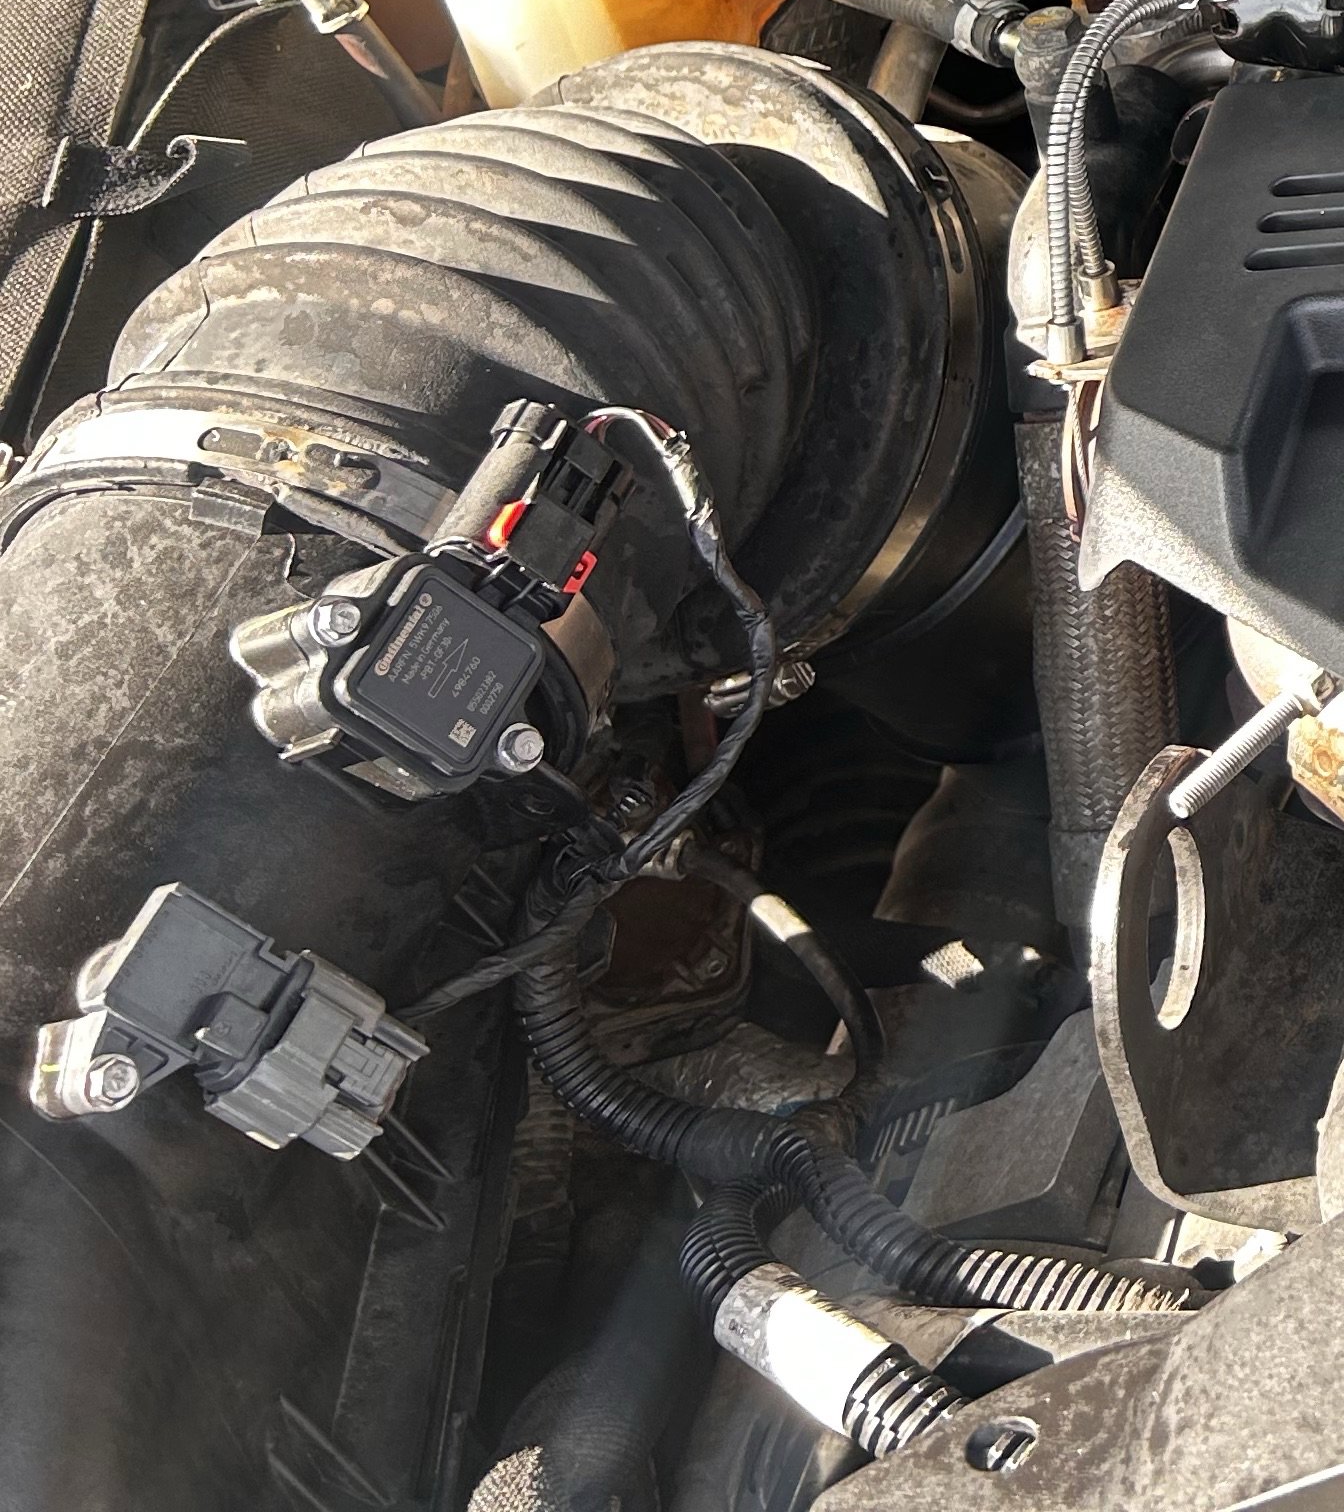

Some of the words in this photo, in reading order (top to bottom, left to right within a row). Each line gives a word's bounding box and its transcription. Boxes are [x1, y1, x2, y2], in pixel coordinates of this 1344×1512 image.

[374, 603, 426, 676] Continental
[421, 617, 451, 655] Germany
[451, 656, 481, 699] 4984760
